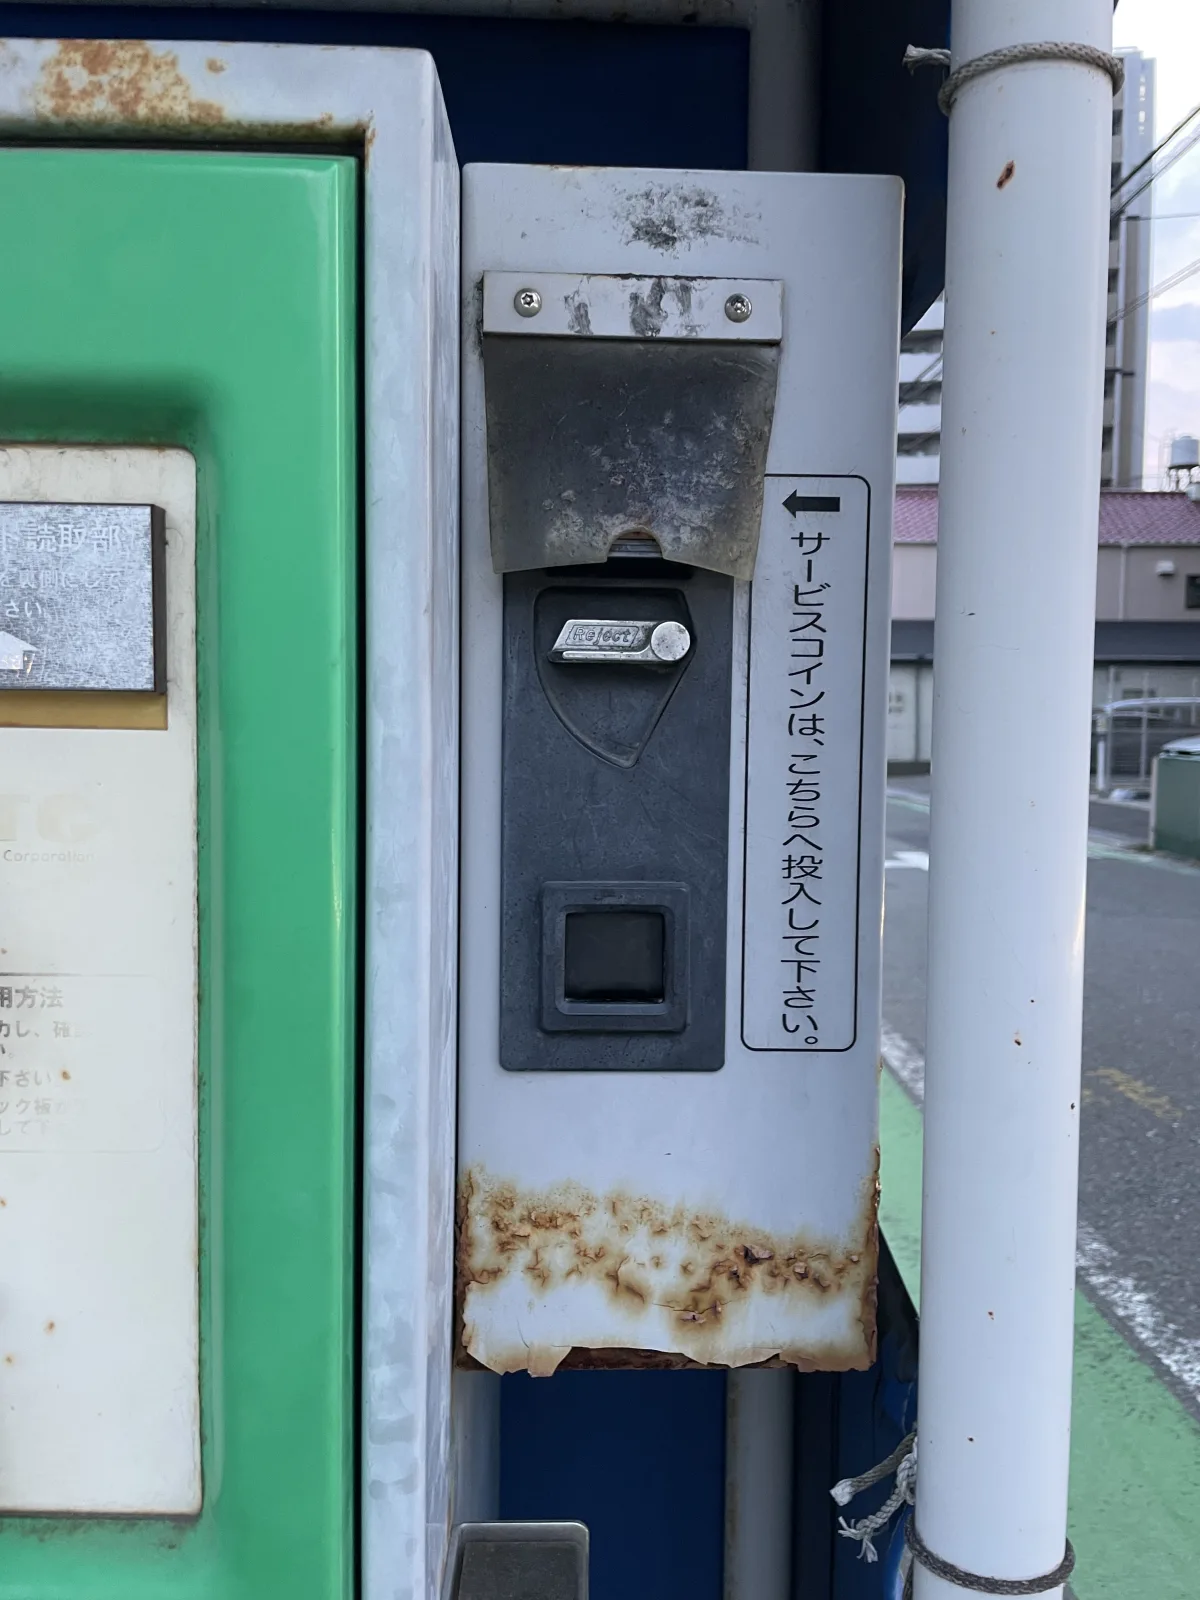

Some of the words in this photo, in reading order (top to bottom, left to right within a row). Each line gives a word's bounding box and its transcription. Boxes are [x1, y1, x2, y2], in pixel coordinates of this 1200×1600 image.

[572, 626, 632, 645] Reject
[780, 531, 831, 1045] サービスコインは、こちらへ投入して下さい。
[3, 849, 94, 864] Corporation
